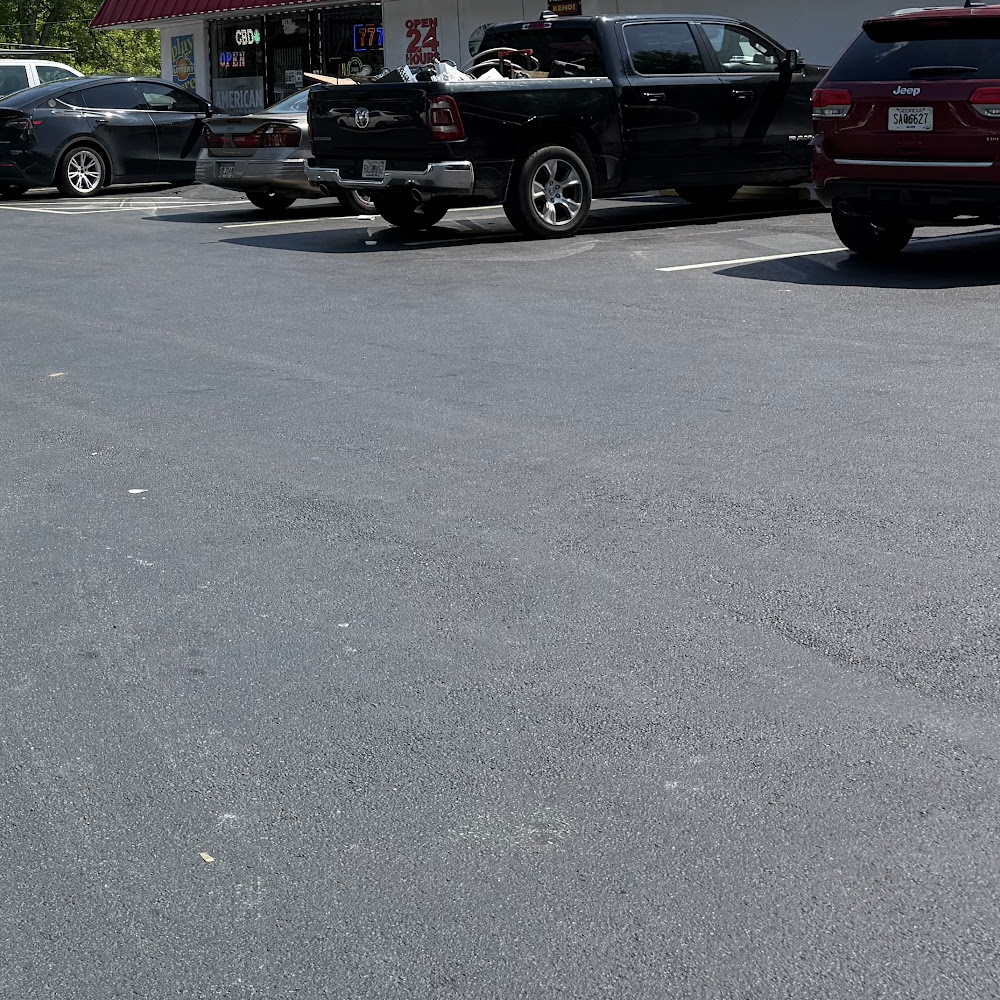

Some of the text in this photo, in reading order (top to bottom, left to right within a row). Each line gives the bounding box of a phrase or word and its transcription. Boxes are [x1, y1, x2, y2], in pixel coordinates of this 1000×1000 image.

[552, 3, 576, 12] KENO!
[405, 17, 438, 30] OPEN
[235, 28, 254, 46] CBD
[358, 27, 384, 47] 777
[406, 28, 440, 54] 24
[171, 37, 194, 64] play
[219, 50, 246, 68] OPEN
[215, 89, 264, 109] AMERICAN
[892, 85, 921, 97] Jeep
